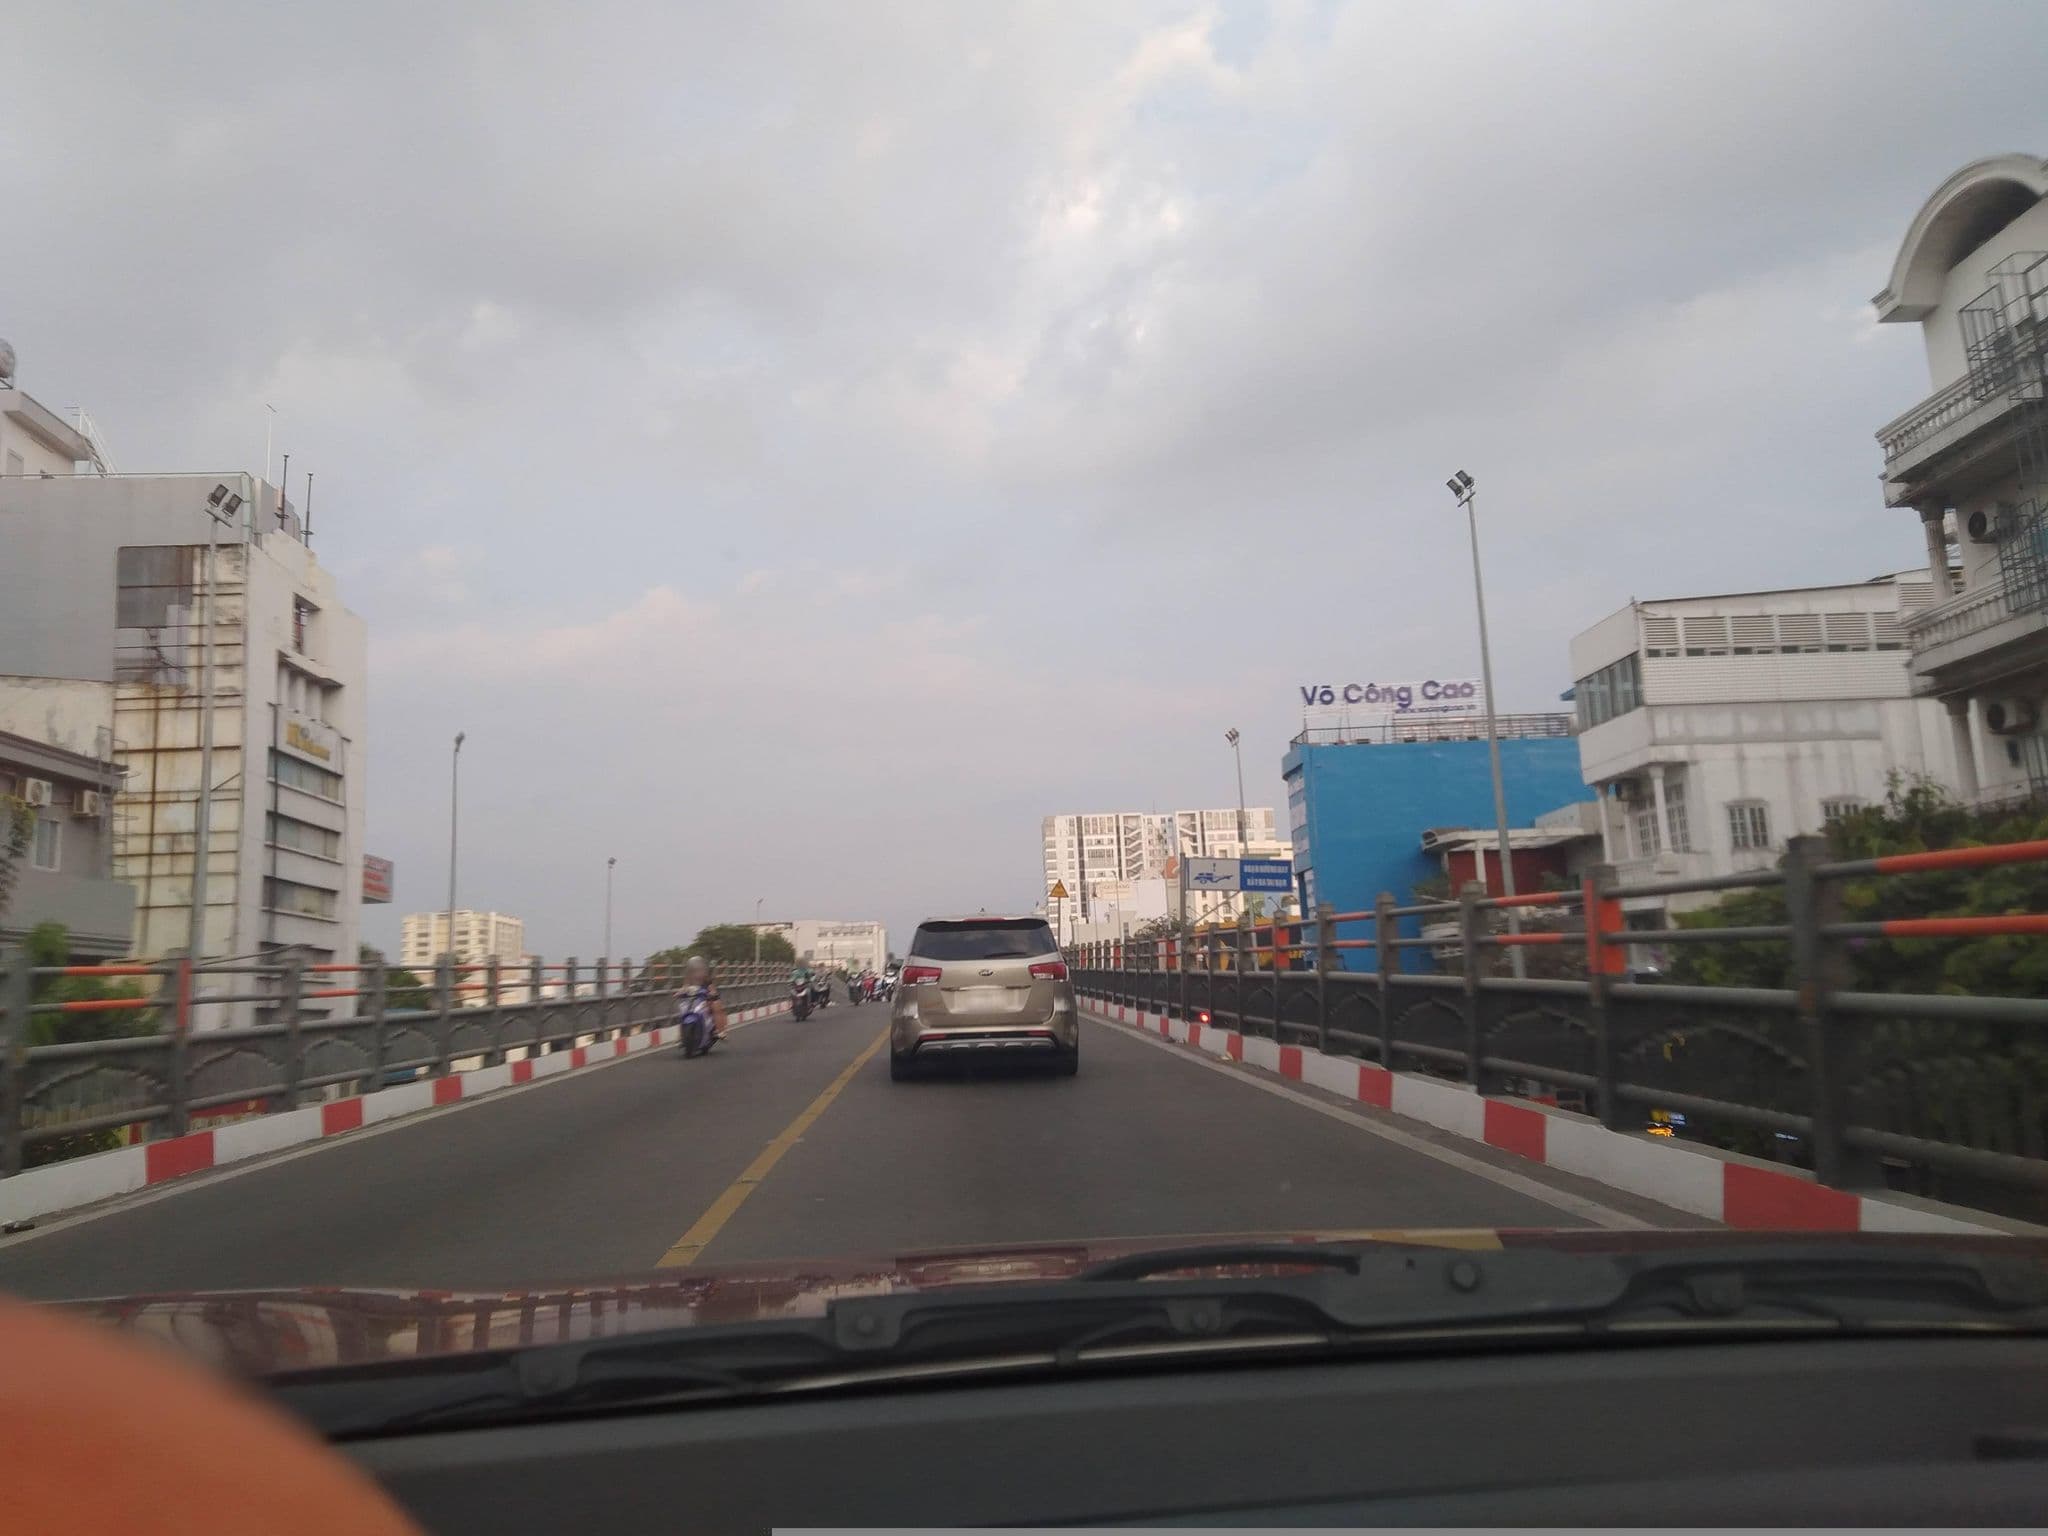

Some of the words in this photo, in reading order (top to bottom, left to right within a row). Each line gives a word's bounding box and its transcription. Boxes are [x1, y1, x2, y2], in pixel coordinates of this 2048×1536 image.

[1301, 685, 1335, 706] Võ
[1344, 682, 1413, 708] Công
[1422, 680, 1475, 700] Cao
